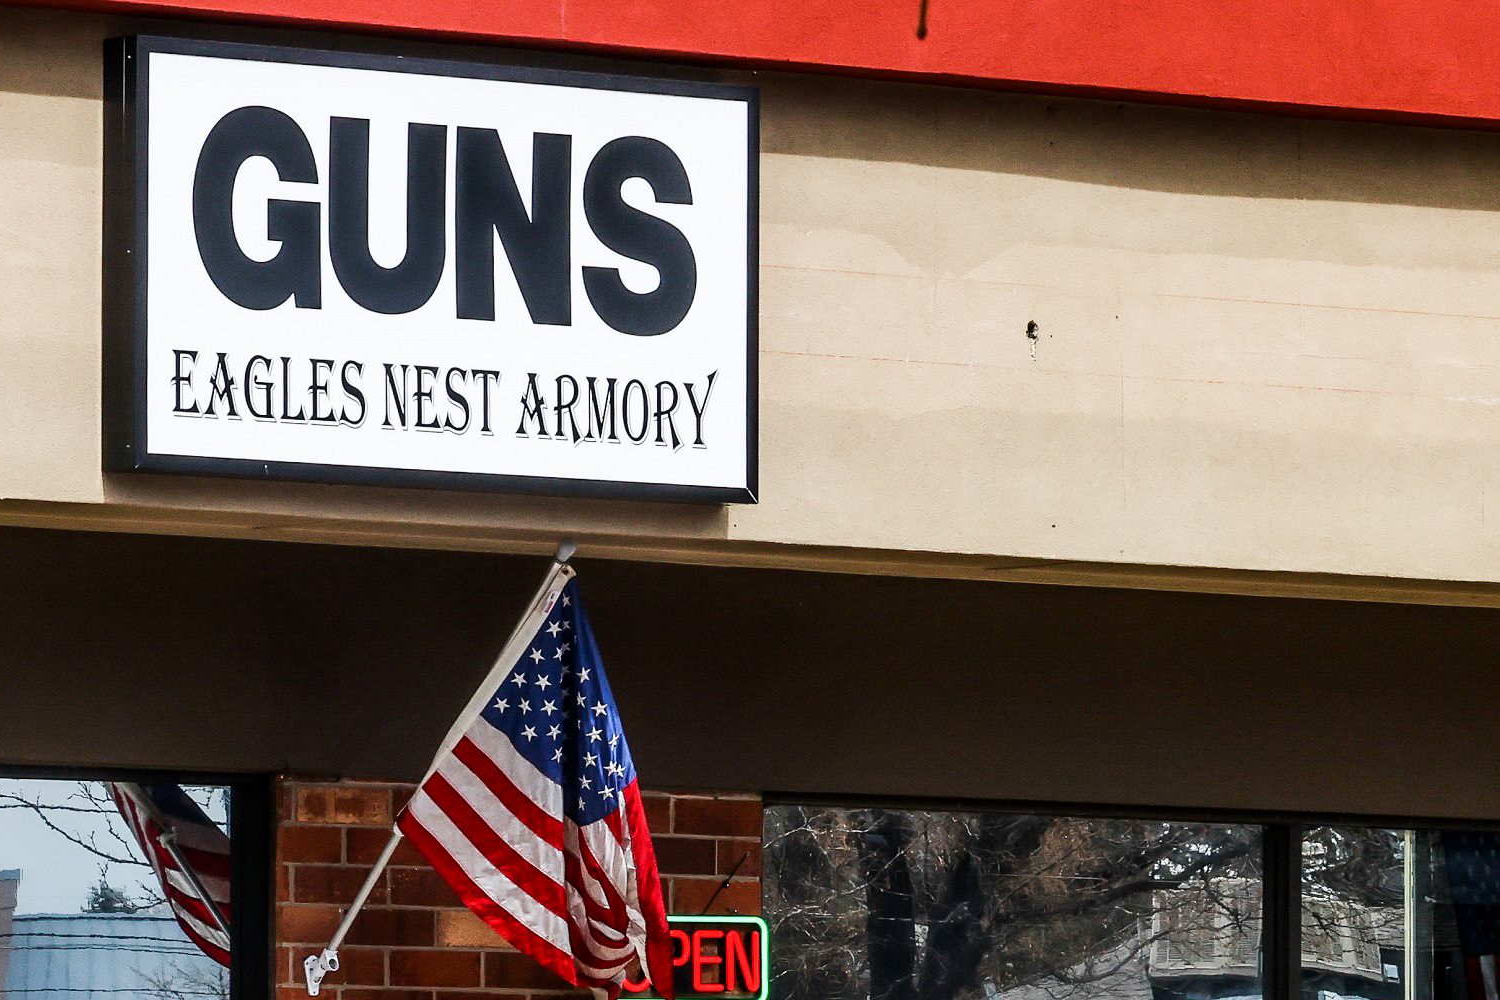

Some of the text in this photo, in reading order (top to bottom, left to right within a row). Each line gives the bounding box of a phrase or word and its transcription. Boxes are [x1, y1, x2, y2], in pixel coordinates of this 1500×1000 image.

[192, 105, 697, 336] GUNS
[171, 349, 718, 453] EAGLES NEST ARMORY
[622, 929, 760, 992] PEN
